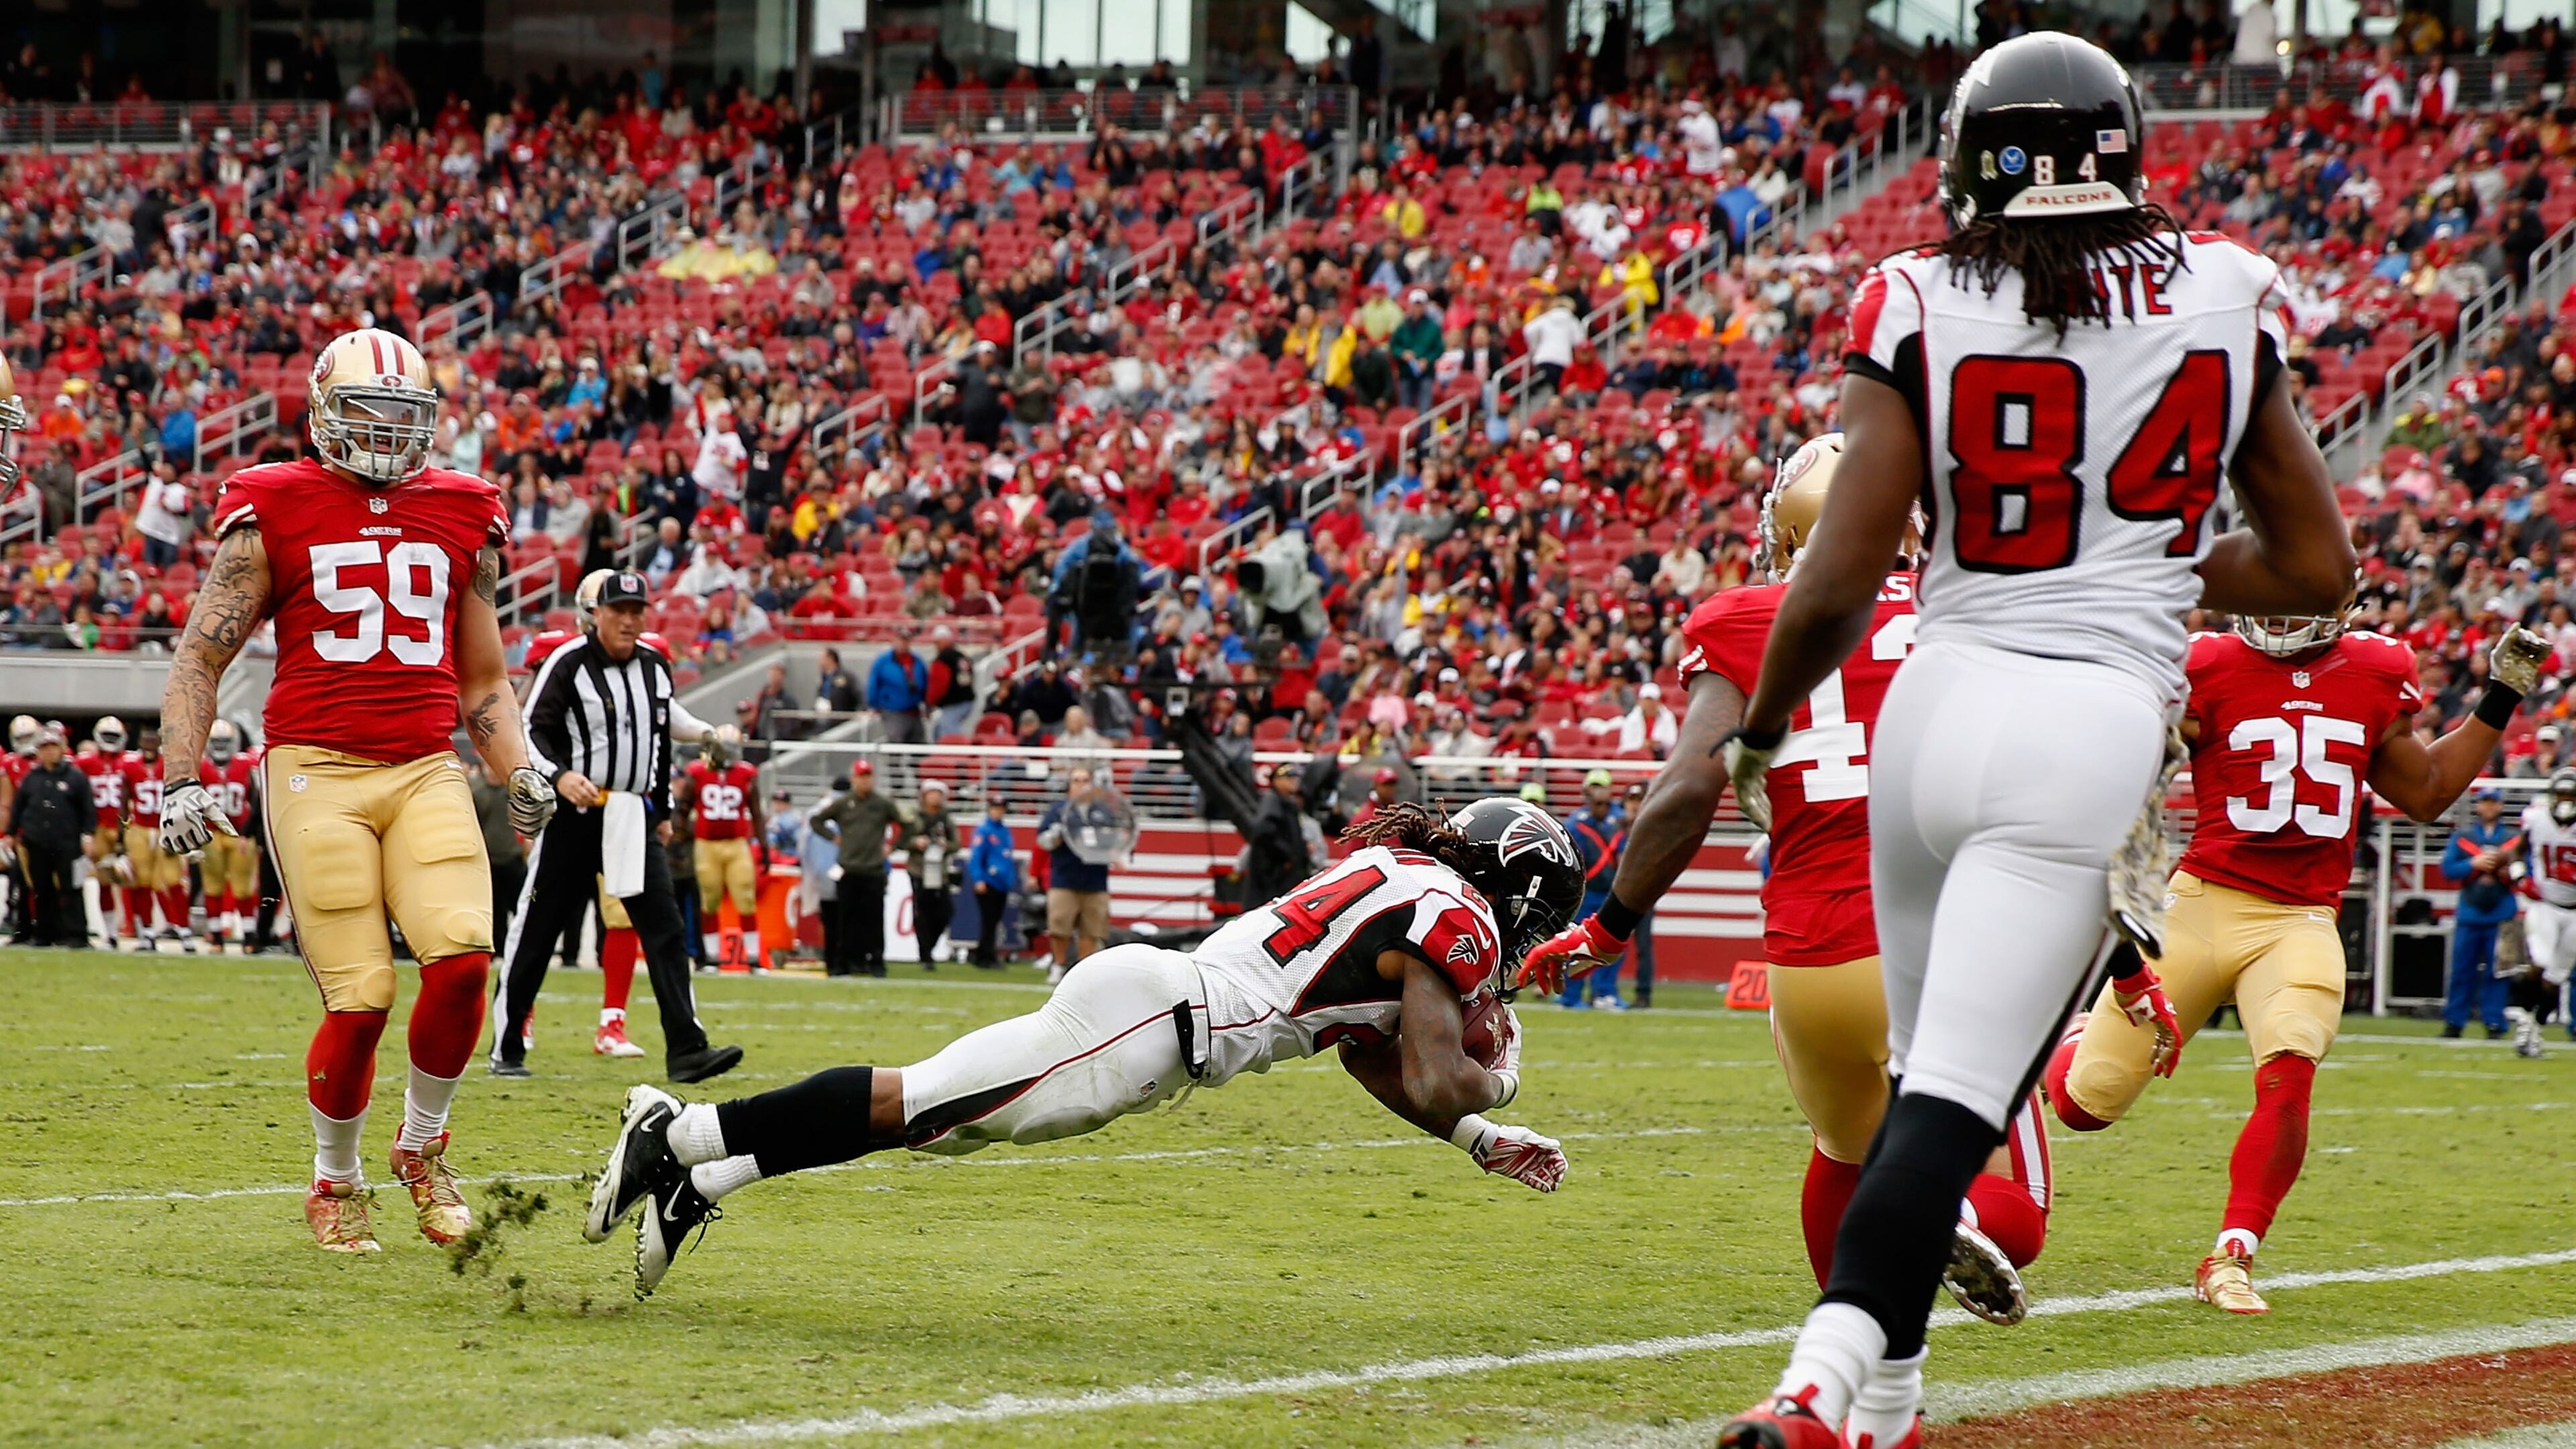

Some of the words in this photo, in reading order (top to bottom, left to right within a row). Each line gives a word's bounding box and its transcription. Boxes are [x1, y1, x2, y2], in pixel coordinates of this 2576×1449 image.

[2025, 191, 2112, 205] FALCONS
[1947, 348, 2231, 575] 84
[308, 539, 451, 667] 59
[701, 783, 743, 820] 92
[2225, 714, 2365, 840] 35
[1733, 969, 1768, 1001] 20
